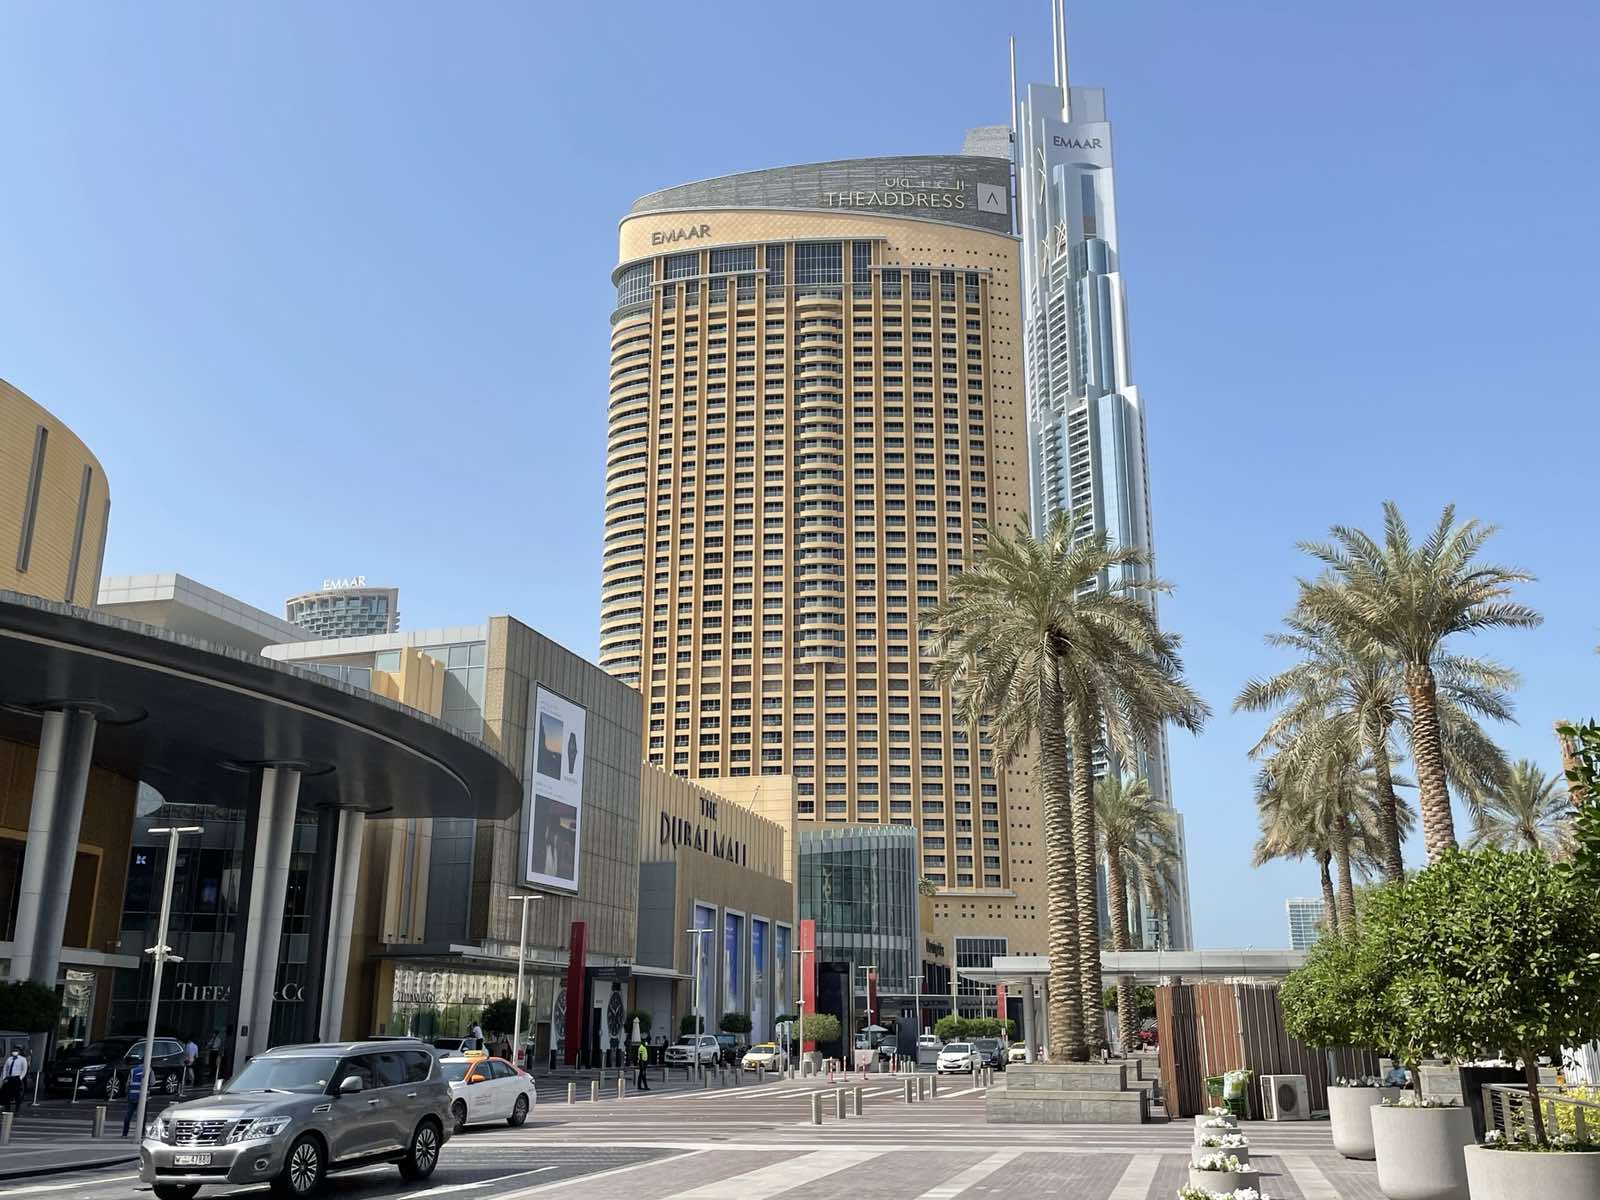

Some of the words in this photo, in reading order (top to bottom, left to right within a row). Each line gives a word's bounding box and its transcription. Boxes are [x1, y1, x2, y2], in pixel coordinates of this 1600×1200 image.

[1053, 135, 1102, 149] EMAAR
[652, 224, 711, 246] EMAAR
[324, 576, 365, 590] EMAAR
[700, 796, 718, 821] THE
[660, 811, 708, 853] DUBAI
